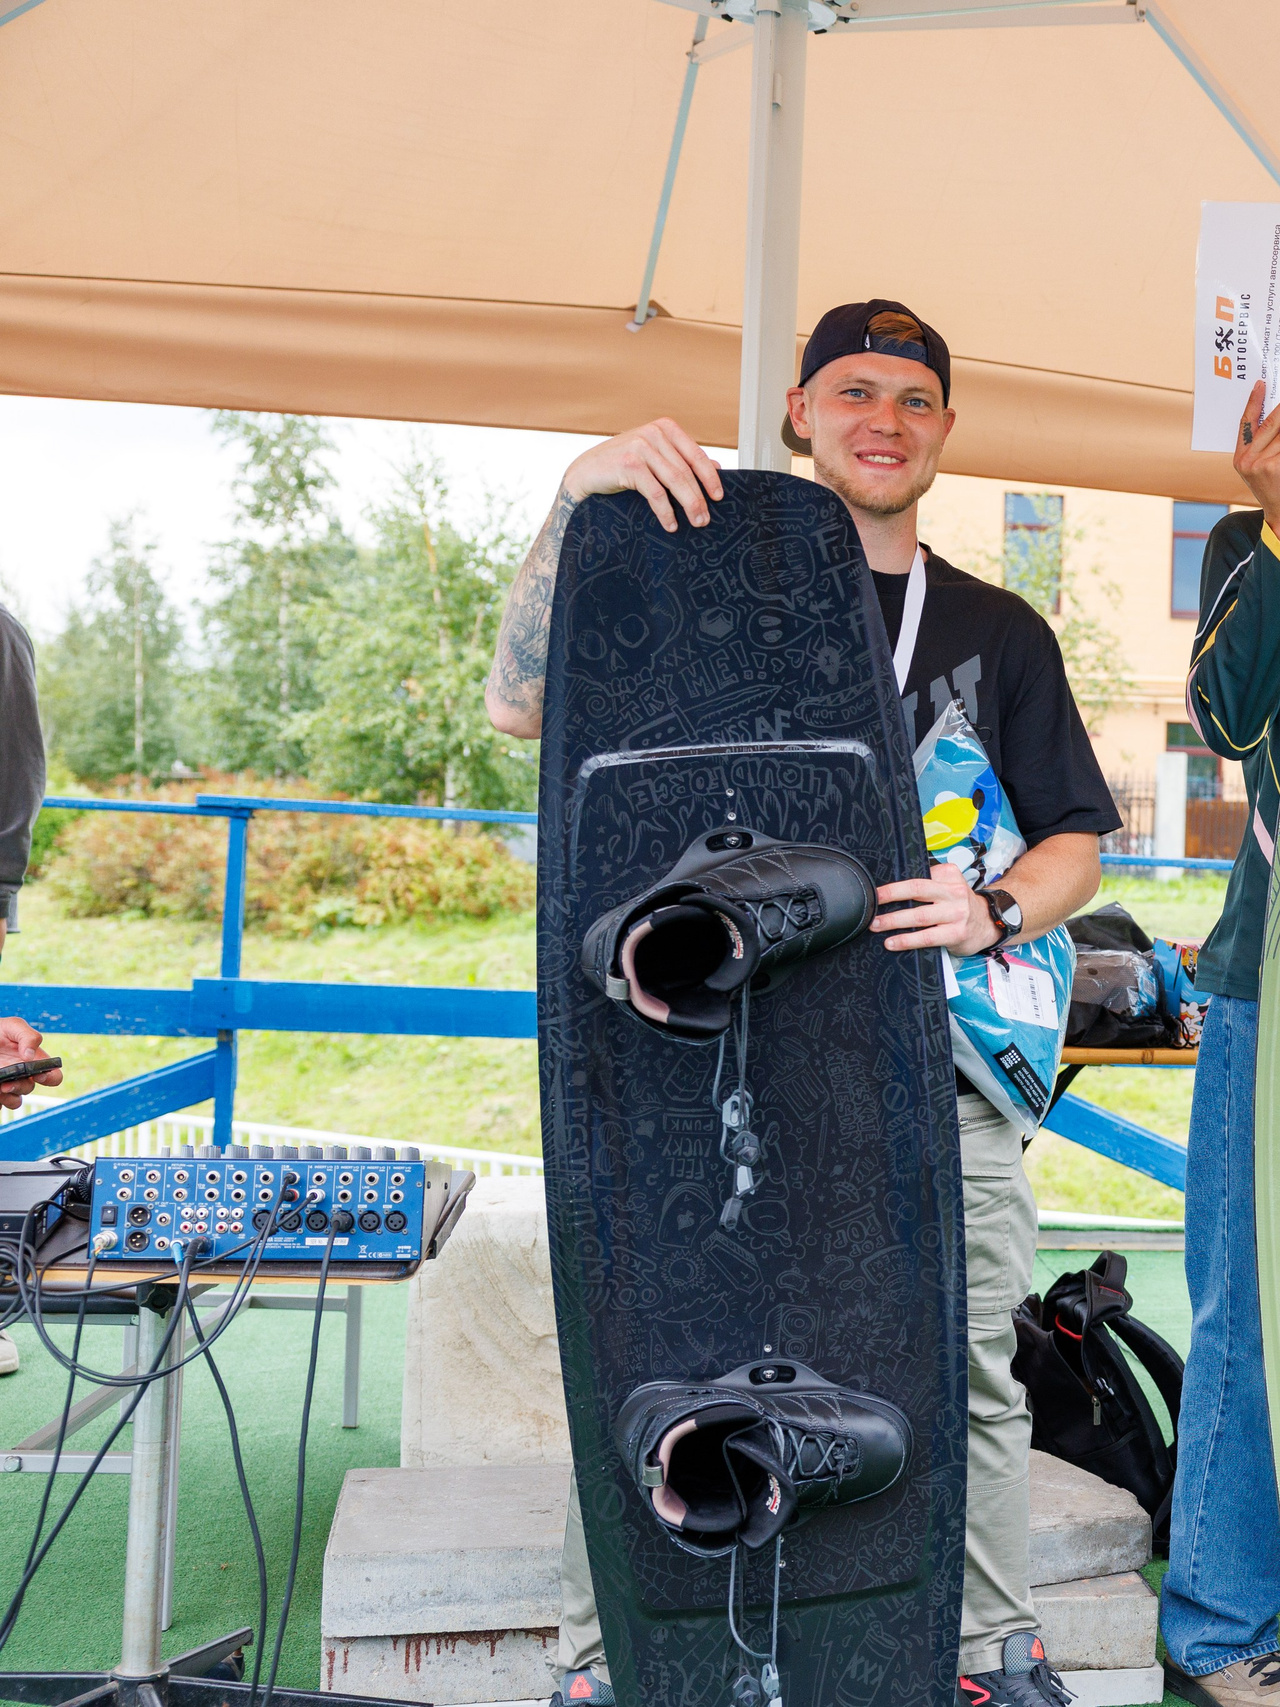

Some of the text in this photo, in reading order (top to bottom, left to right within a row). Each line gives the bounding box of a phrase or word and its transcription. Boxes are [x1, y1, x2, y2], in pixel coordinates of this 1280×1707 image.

[1269, 224, 1280, 280] автосервиса
[1265, 314, 1272, 324] на
[1267, 282, 1276, 312] услуги
[1237, 293, 1250, 380] АВТОСЕРВИС
[1261, 326, 1271, 378] сертификат
[618, 673, 680, 726] TRY
[670, 1118, 714, 1132] PUNK
